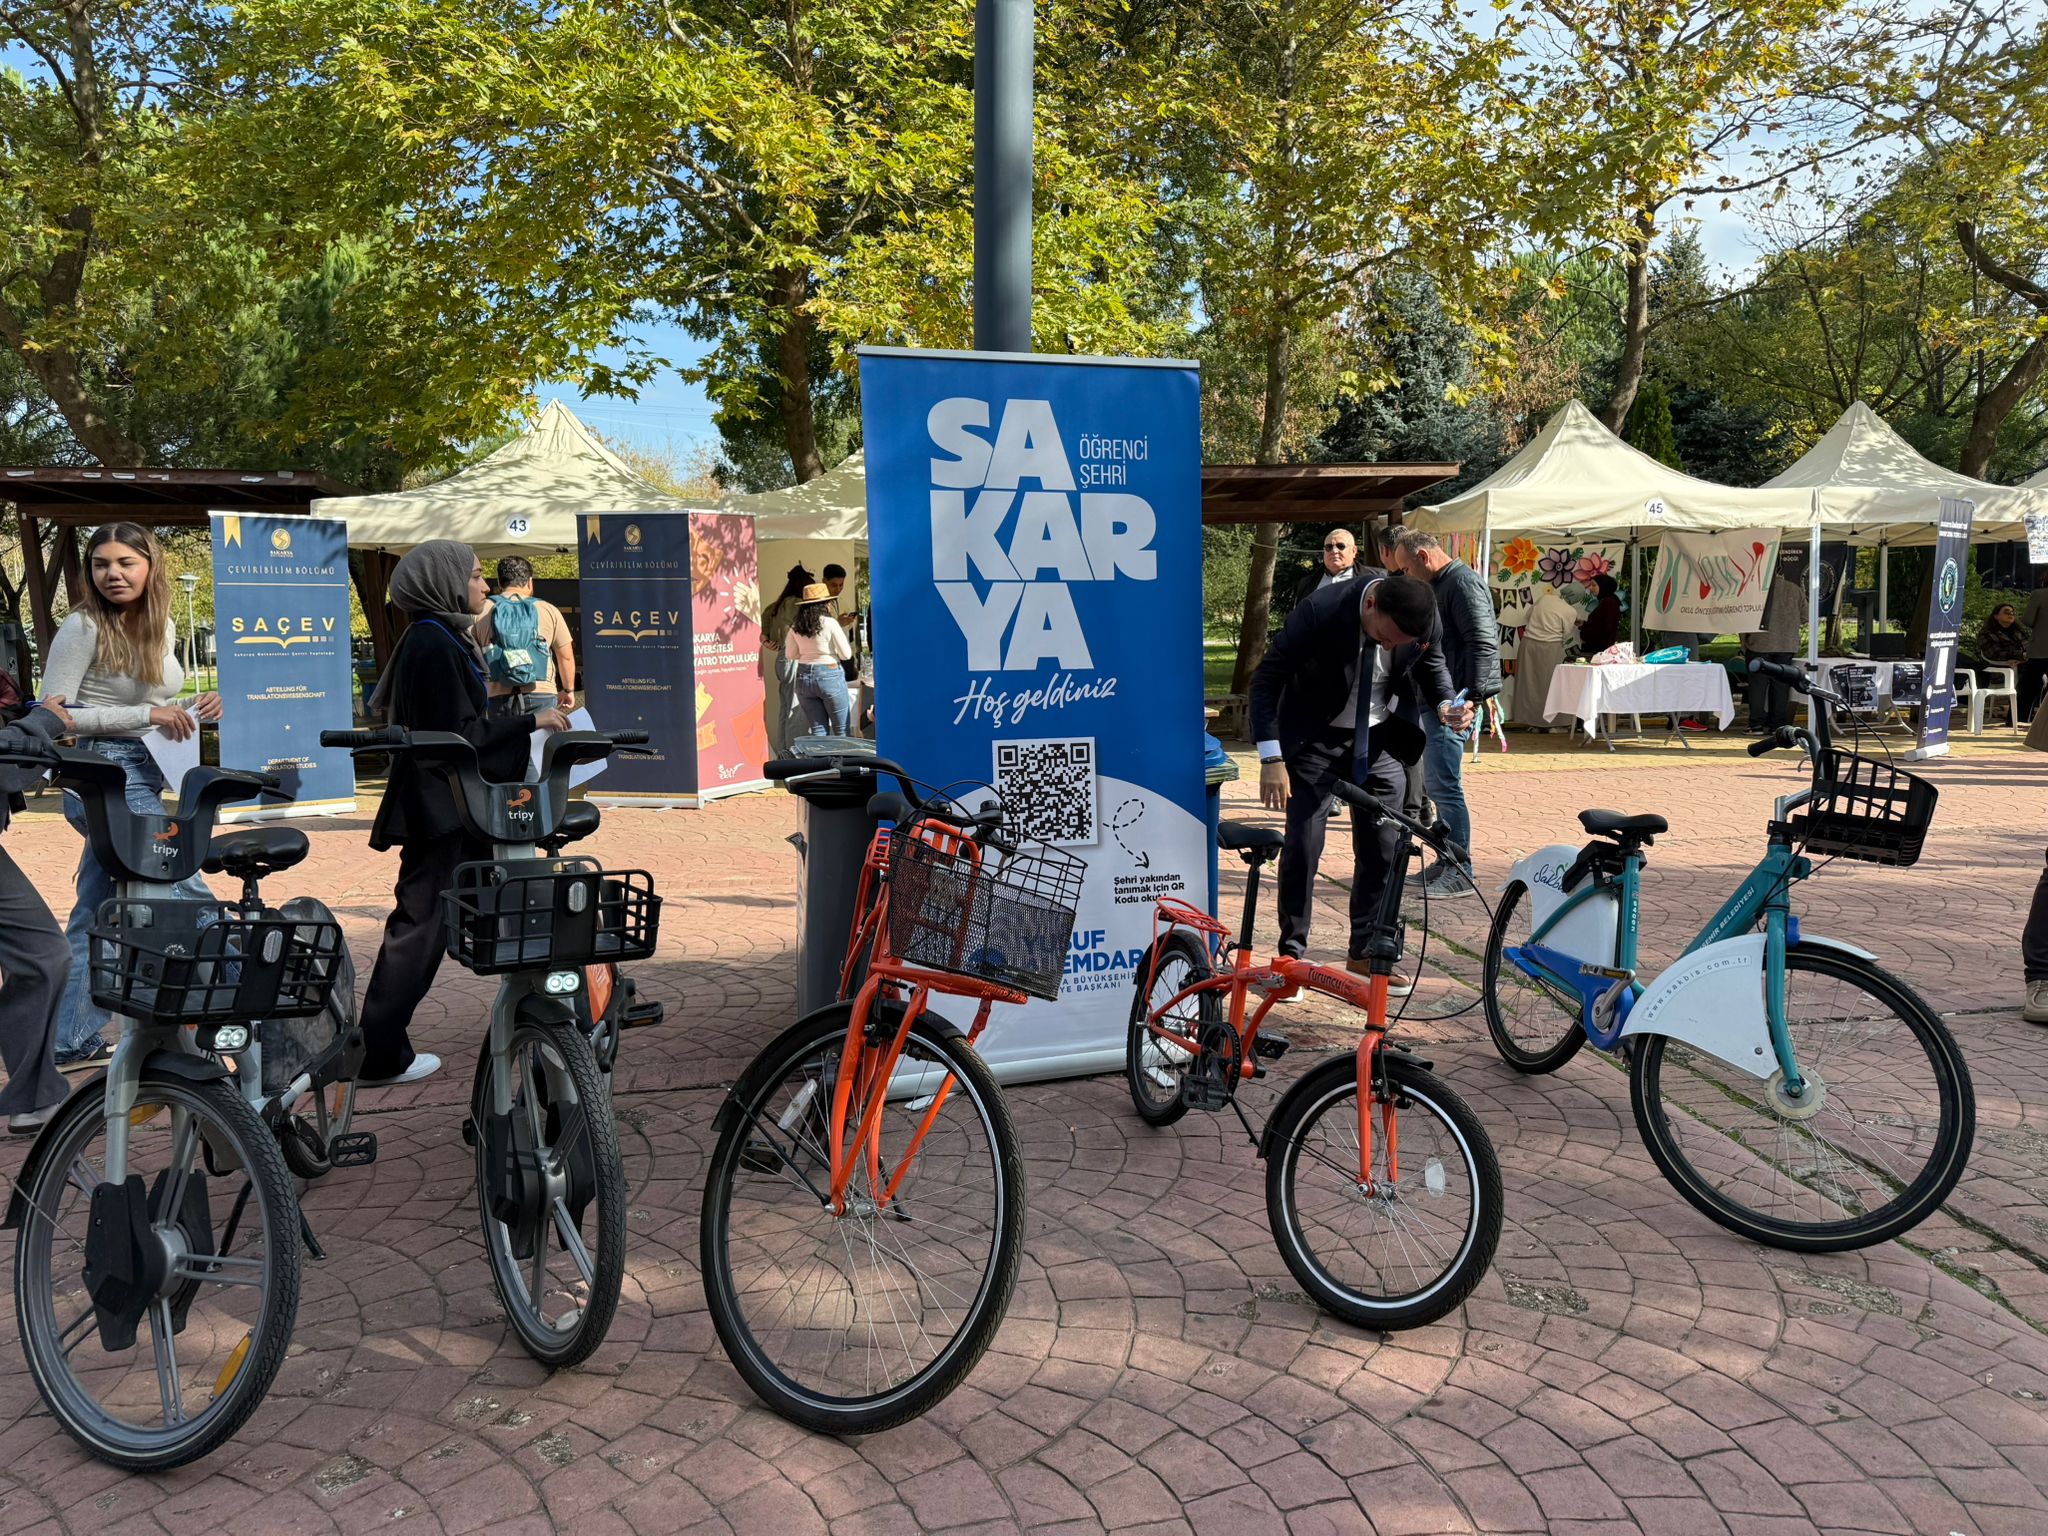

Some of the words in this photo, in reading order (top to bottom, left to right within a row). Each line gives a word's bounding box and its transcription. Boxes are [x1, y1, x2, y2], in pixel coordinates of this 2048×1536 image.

[1079, 433, 1149, 460] ÖĞRENCİ
[1080, 461, 1127, 489] ŞEHRİ
[1648, 503, 1664, 515] 45
[509, 519, 528, 532] 43
[227, 565, 293, 575] ÇEVİRİBİLİM
[295, 566, 335, 575] BÖLÜMÜ
[593, 610, 679, 628] SAÇEV
[231, 617, 335, 635] SAÇEV
[693, 632, 721, 643] KARYA
[718, 651, 760, 665] TOPLULUĞU
[953, 676, 1011, 729] Hoş
[1011, 672, 1118, 725] geldiniz
[260, 764, 295, 772] TRANSLATION
[508, 810, 535, 822] tripy
[152, 843, 179, 858] tripy
[1114, 875, 1138, 886] Şehri
[1139, 873, 1181, 884] yakından
[1534, 863, 1563, 893] Sakb
[1114, 884, 1151, 895] tanımak
[1171, 882, 1185, 891] QR
[1114, 895, 1139, 905] Kodu
[1719, 885, 1756, 929] BELEDİYESİ
[1062, 948, 1145, 975] EMDAR
[1076, 982, 1121, 992] BAŞKANI
